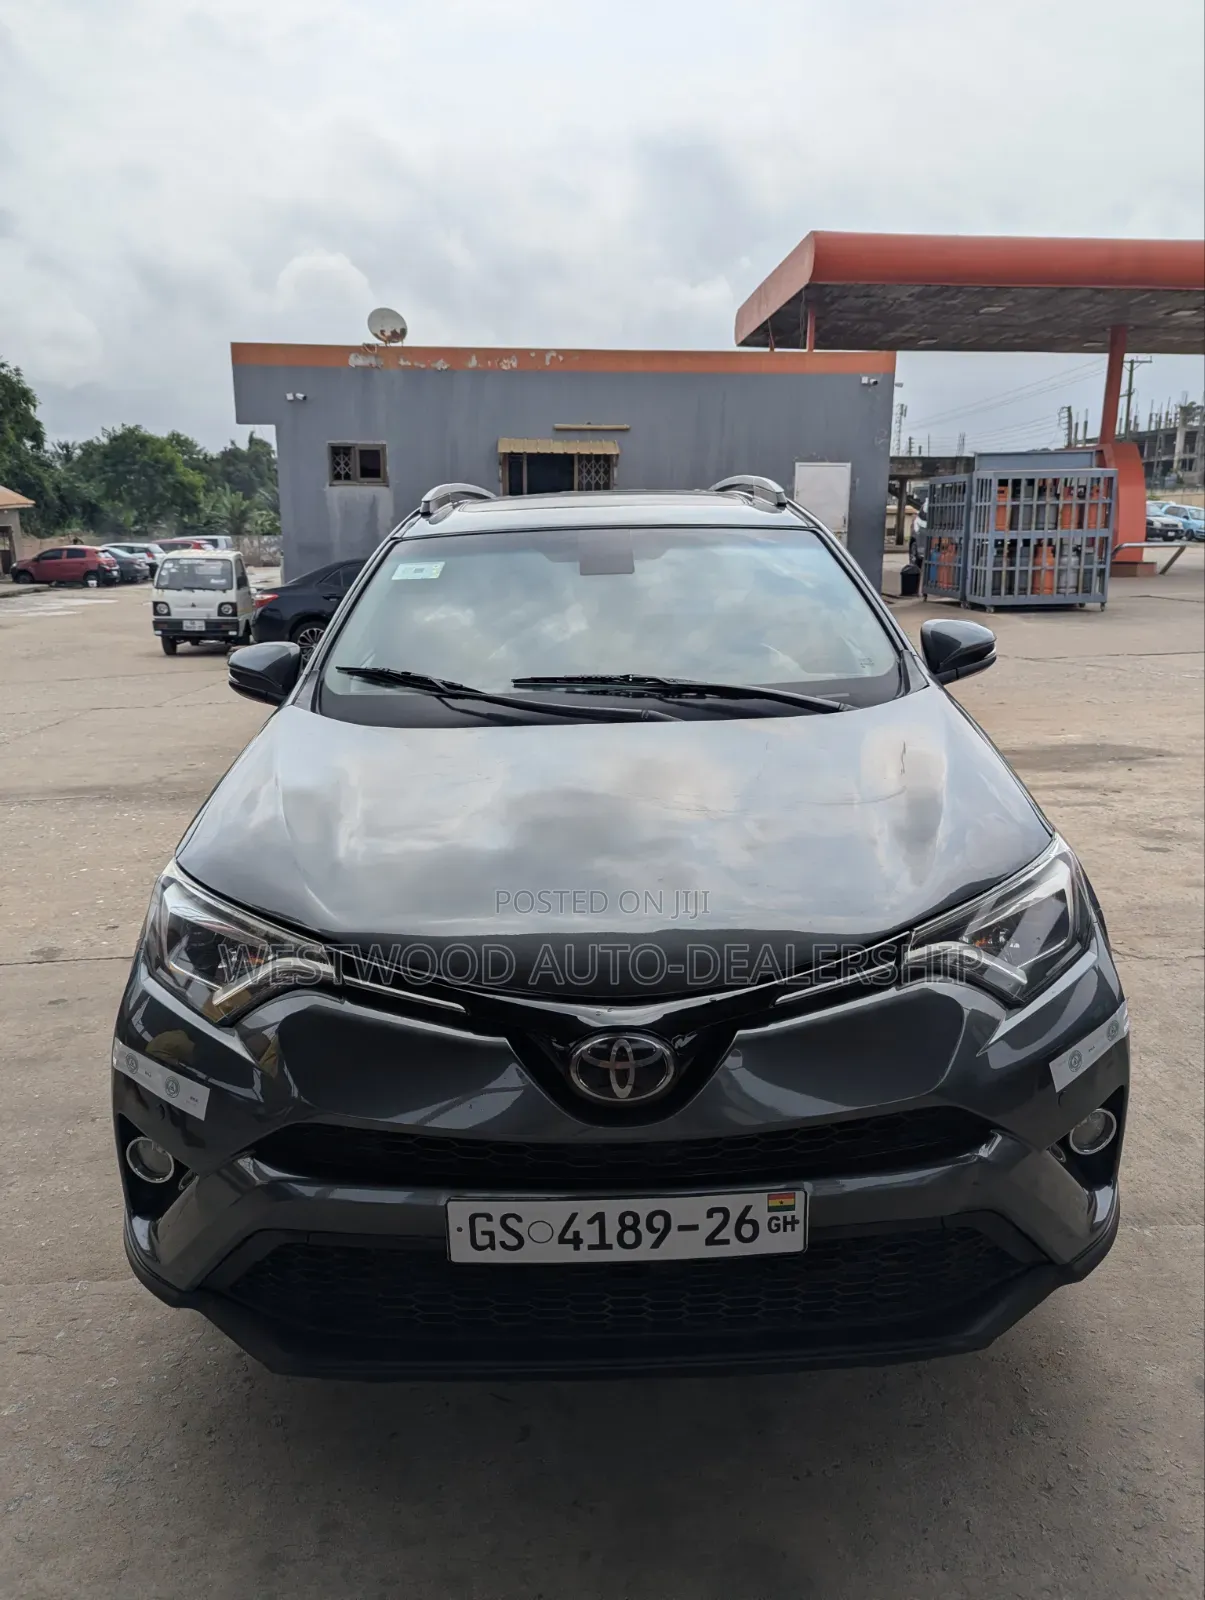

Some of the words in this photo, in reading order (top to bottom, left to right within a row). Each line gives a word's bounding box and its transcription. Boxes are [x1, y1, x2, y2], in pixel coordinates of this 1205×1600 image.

[468, 1212, 525, 1251] GS
[557, 1204, 760, 1251] 4189-26
[767, 1215, 800, 1234] GH
